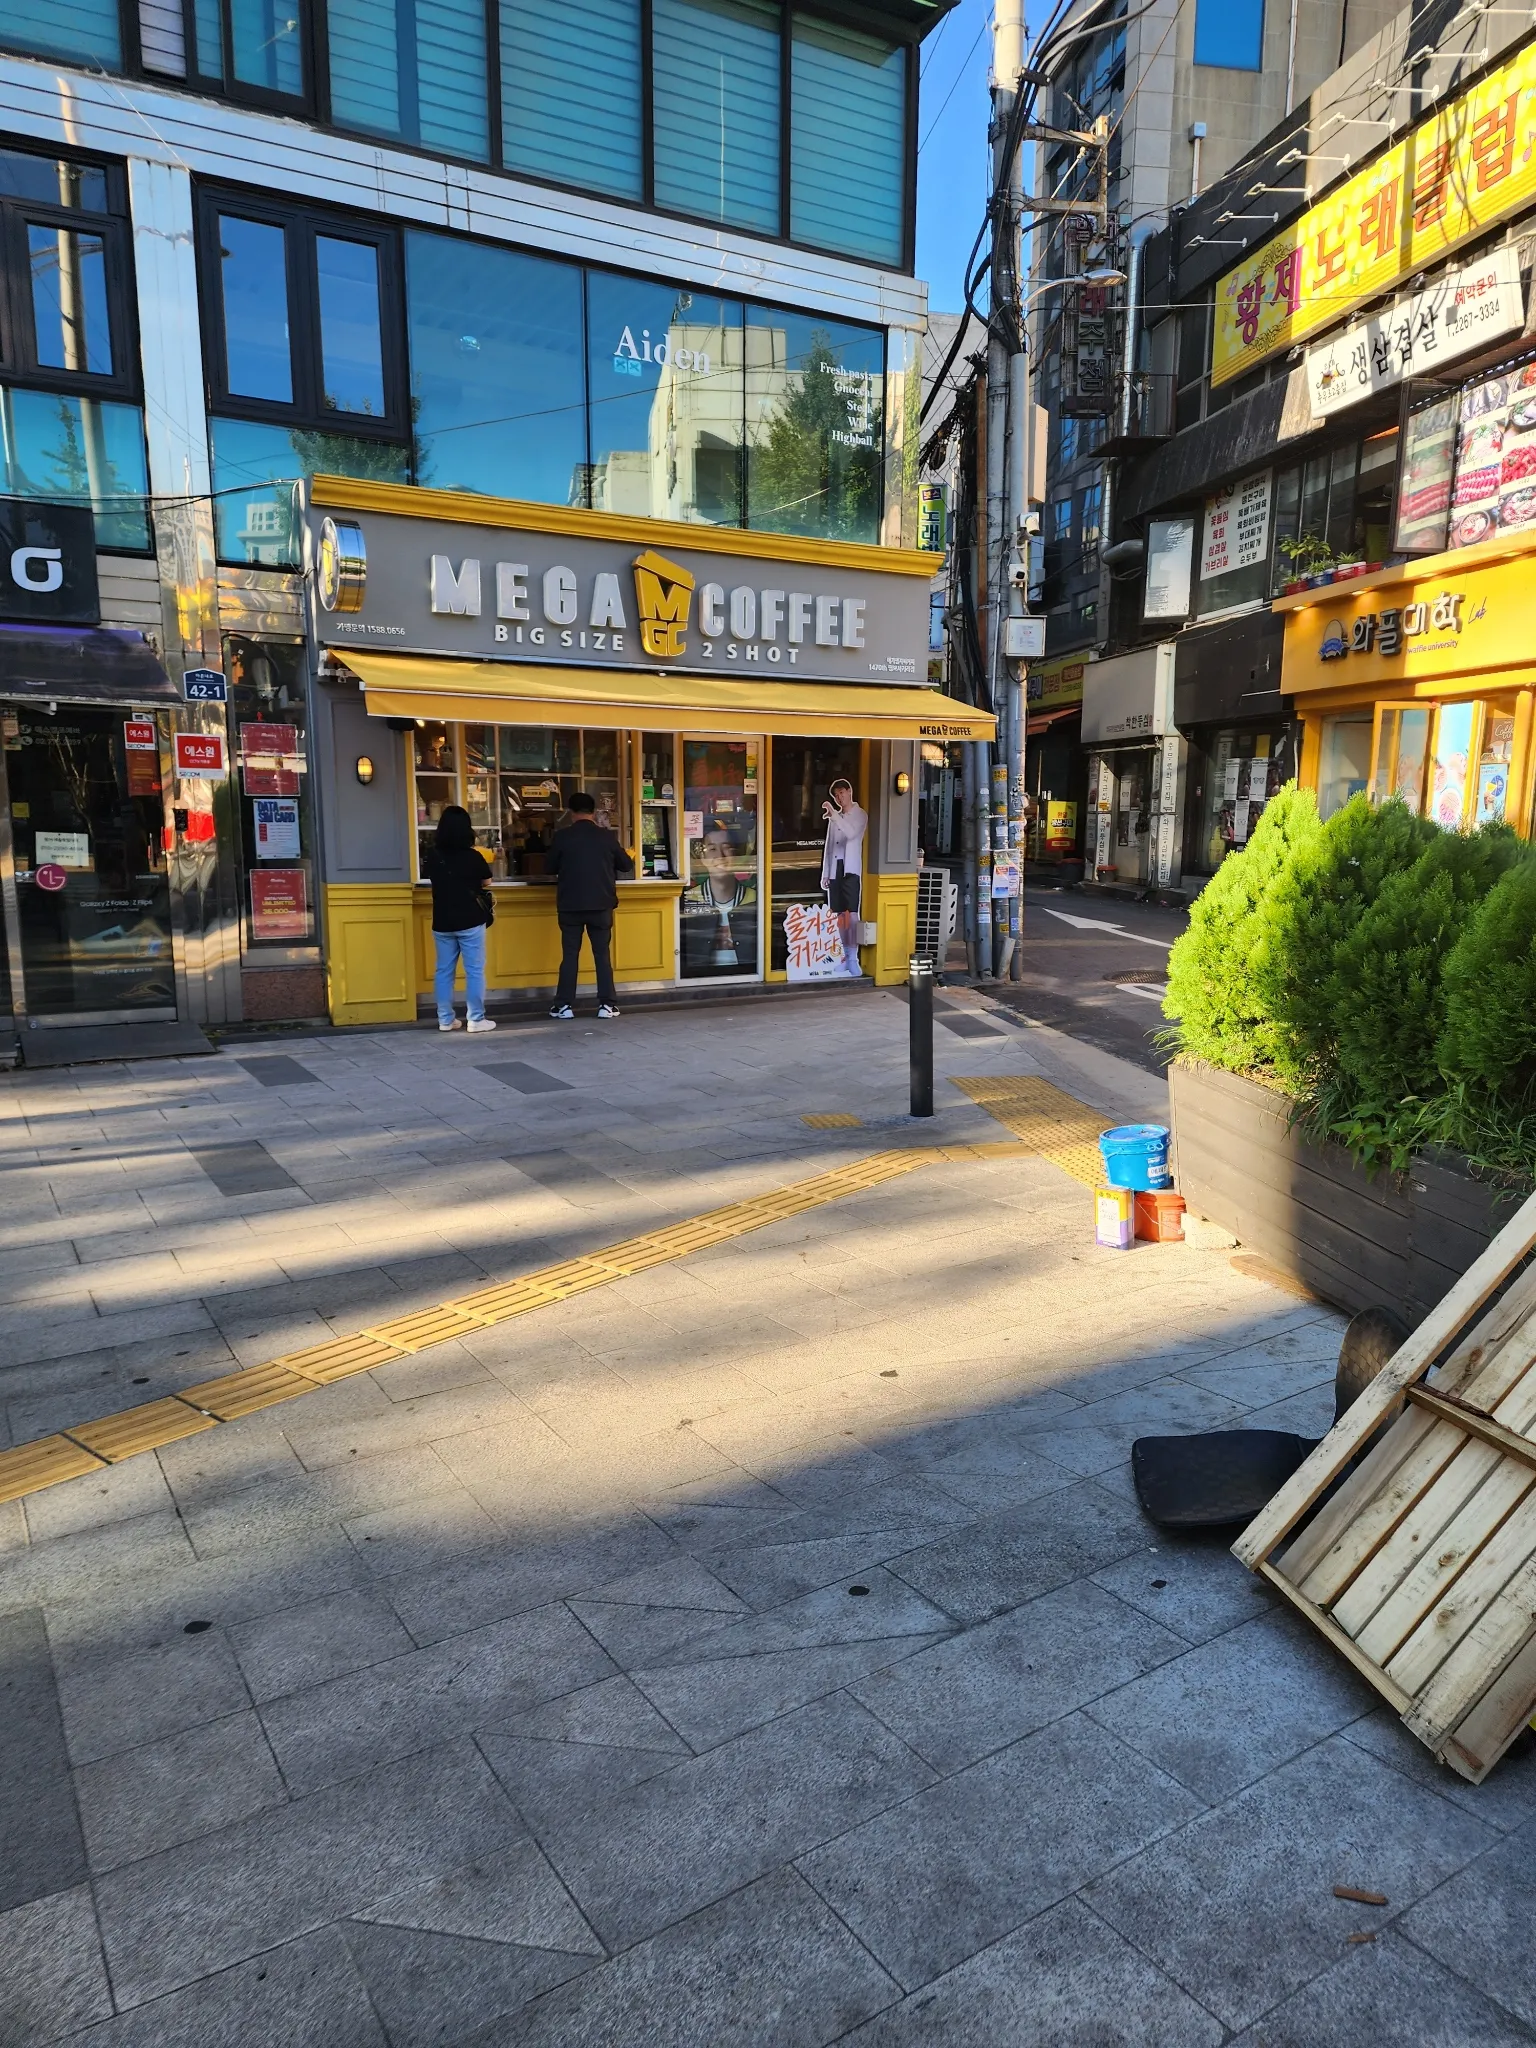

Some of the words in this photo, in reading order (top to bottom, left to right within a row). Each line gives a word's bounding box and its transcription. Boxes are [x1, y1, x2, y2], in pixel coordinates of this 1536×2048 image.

[1235, 245, 1304, 345] 황제
[1313, 88, 1522, 291] 노래클럽
[1454, 271, 1497, 306] 예약문의
[613, 325, 710, 374] Aiden
[1350, 305, 1438, 384] 생삼겹살
[820, 362, 847, 376] Fresh
[849, 371, 872, 381] pasta
[847, 400, 873, 414] Stek
[832, 430, 872, 445] Highball
[431, 554, 627, 629] MEGA
[699, 583, 866, 648] COFFEE
[1351, 591, 1466, 656] 와플대학
[494, 625, 545, 645] BIG
[561, 628, 624, 652] SIZE
[702, 642, 713, 658] 2
[727, 644, 799, 664] SHOT
[1407, 644, 1428, 655] waffle
[1428, 638, 1459, 652] university
[190, 685, 221, 698] 42-1
[129, 730, 150, 738] 에스원
[920, 726, 942, 735] MEGA
[949, 726, 972, 736] COFFEE
[184, 745, 215, 758] 에스원
[274, 811, 295, 822] CARD
[789, 936, 839, 968] 커진다
